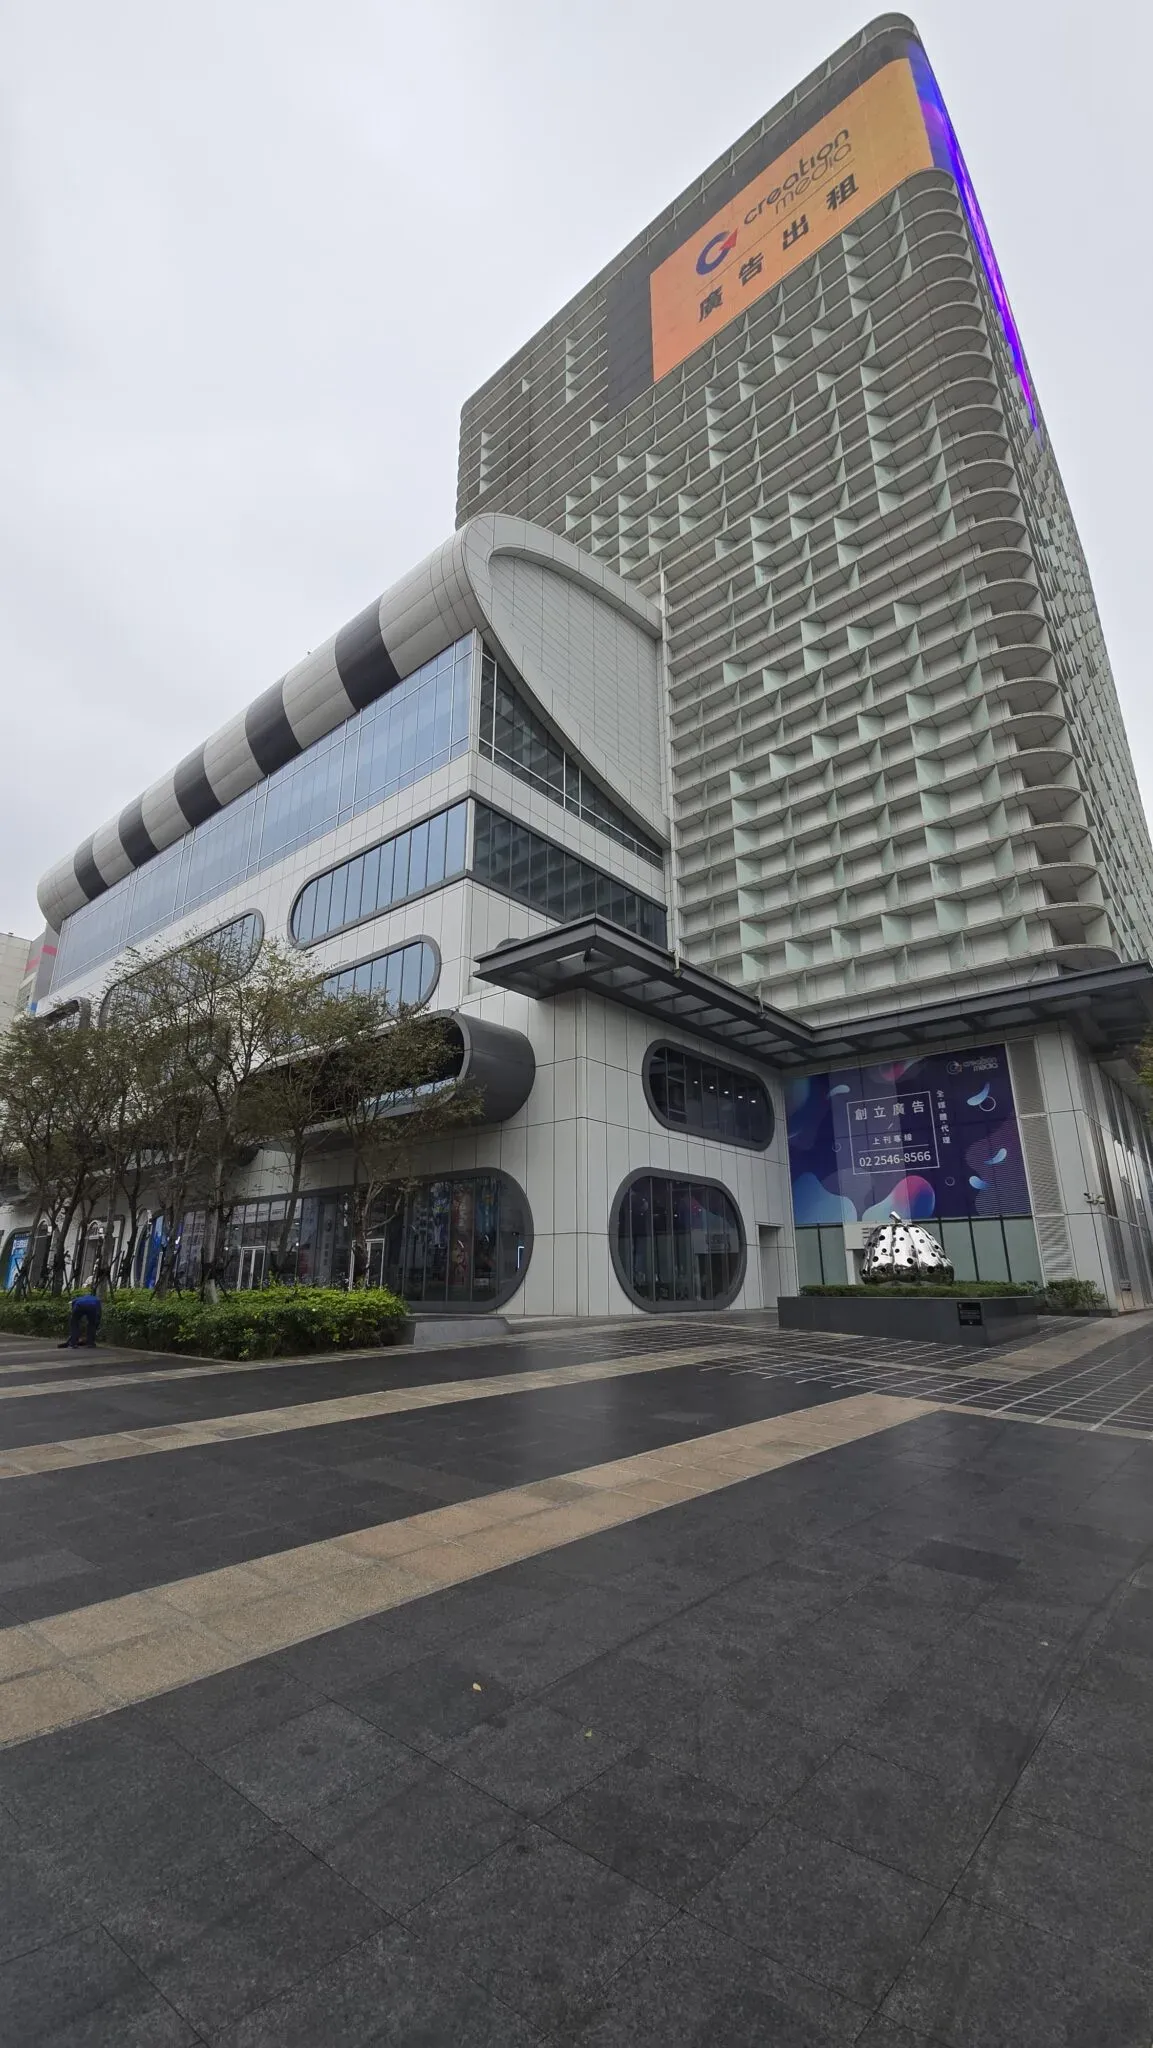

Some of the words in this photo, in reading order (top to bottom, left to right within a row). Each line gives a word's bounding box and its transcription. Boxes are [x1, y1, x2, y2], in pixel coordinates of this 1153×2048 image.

[743, 127, 850, 226] creation
[775, 142, 852, 216] media
[698, 173, 859, 323] 廣告出租
[855, 1100, 925, 1121] 創立廣告
[859, 1157, 872, 1167] 02
[874, 1151, 931, 1166] 2546-8566
